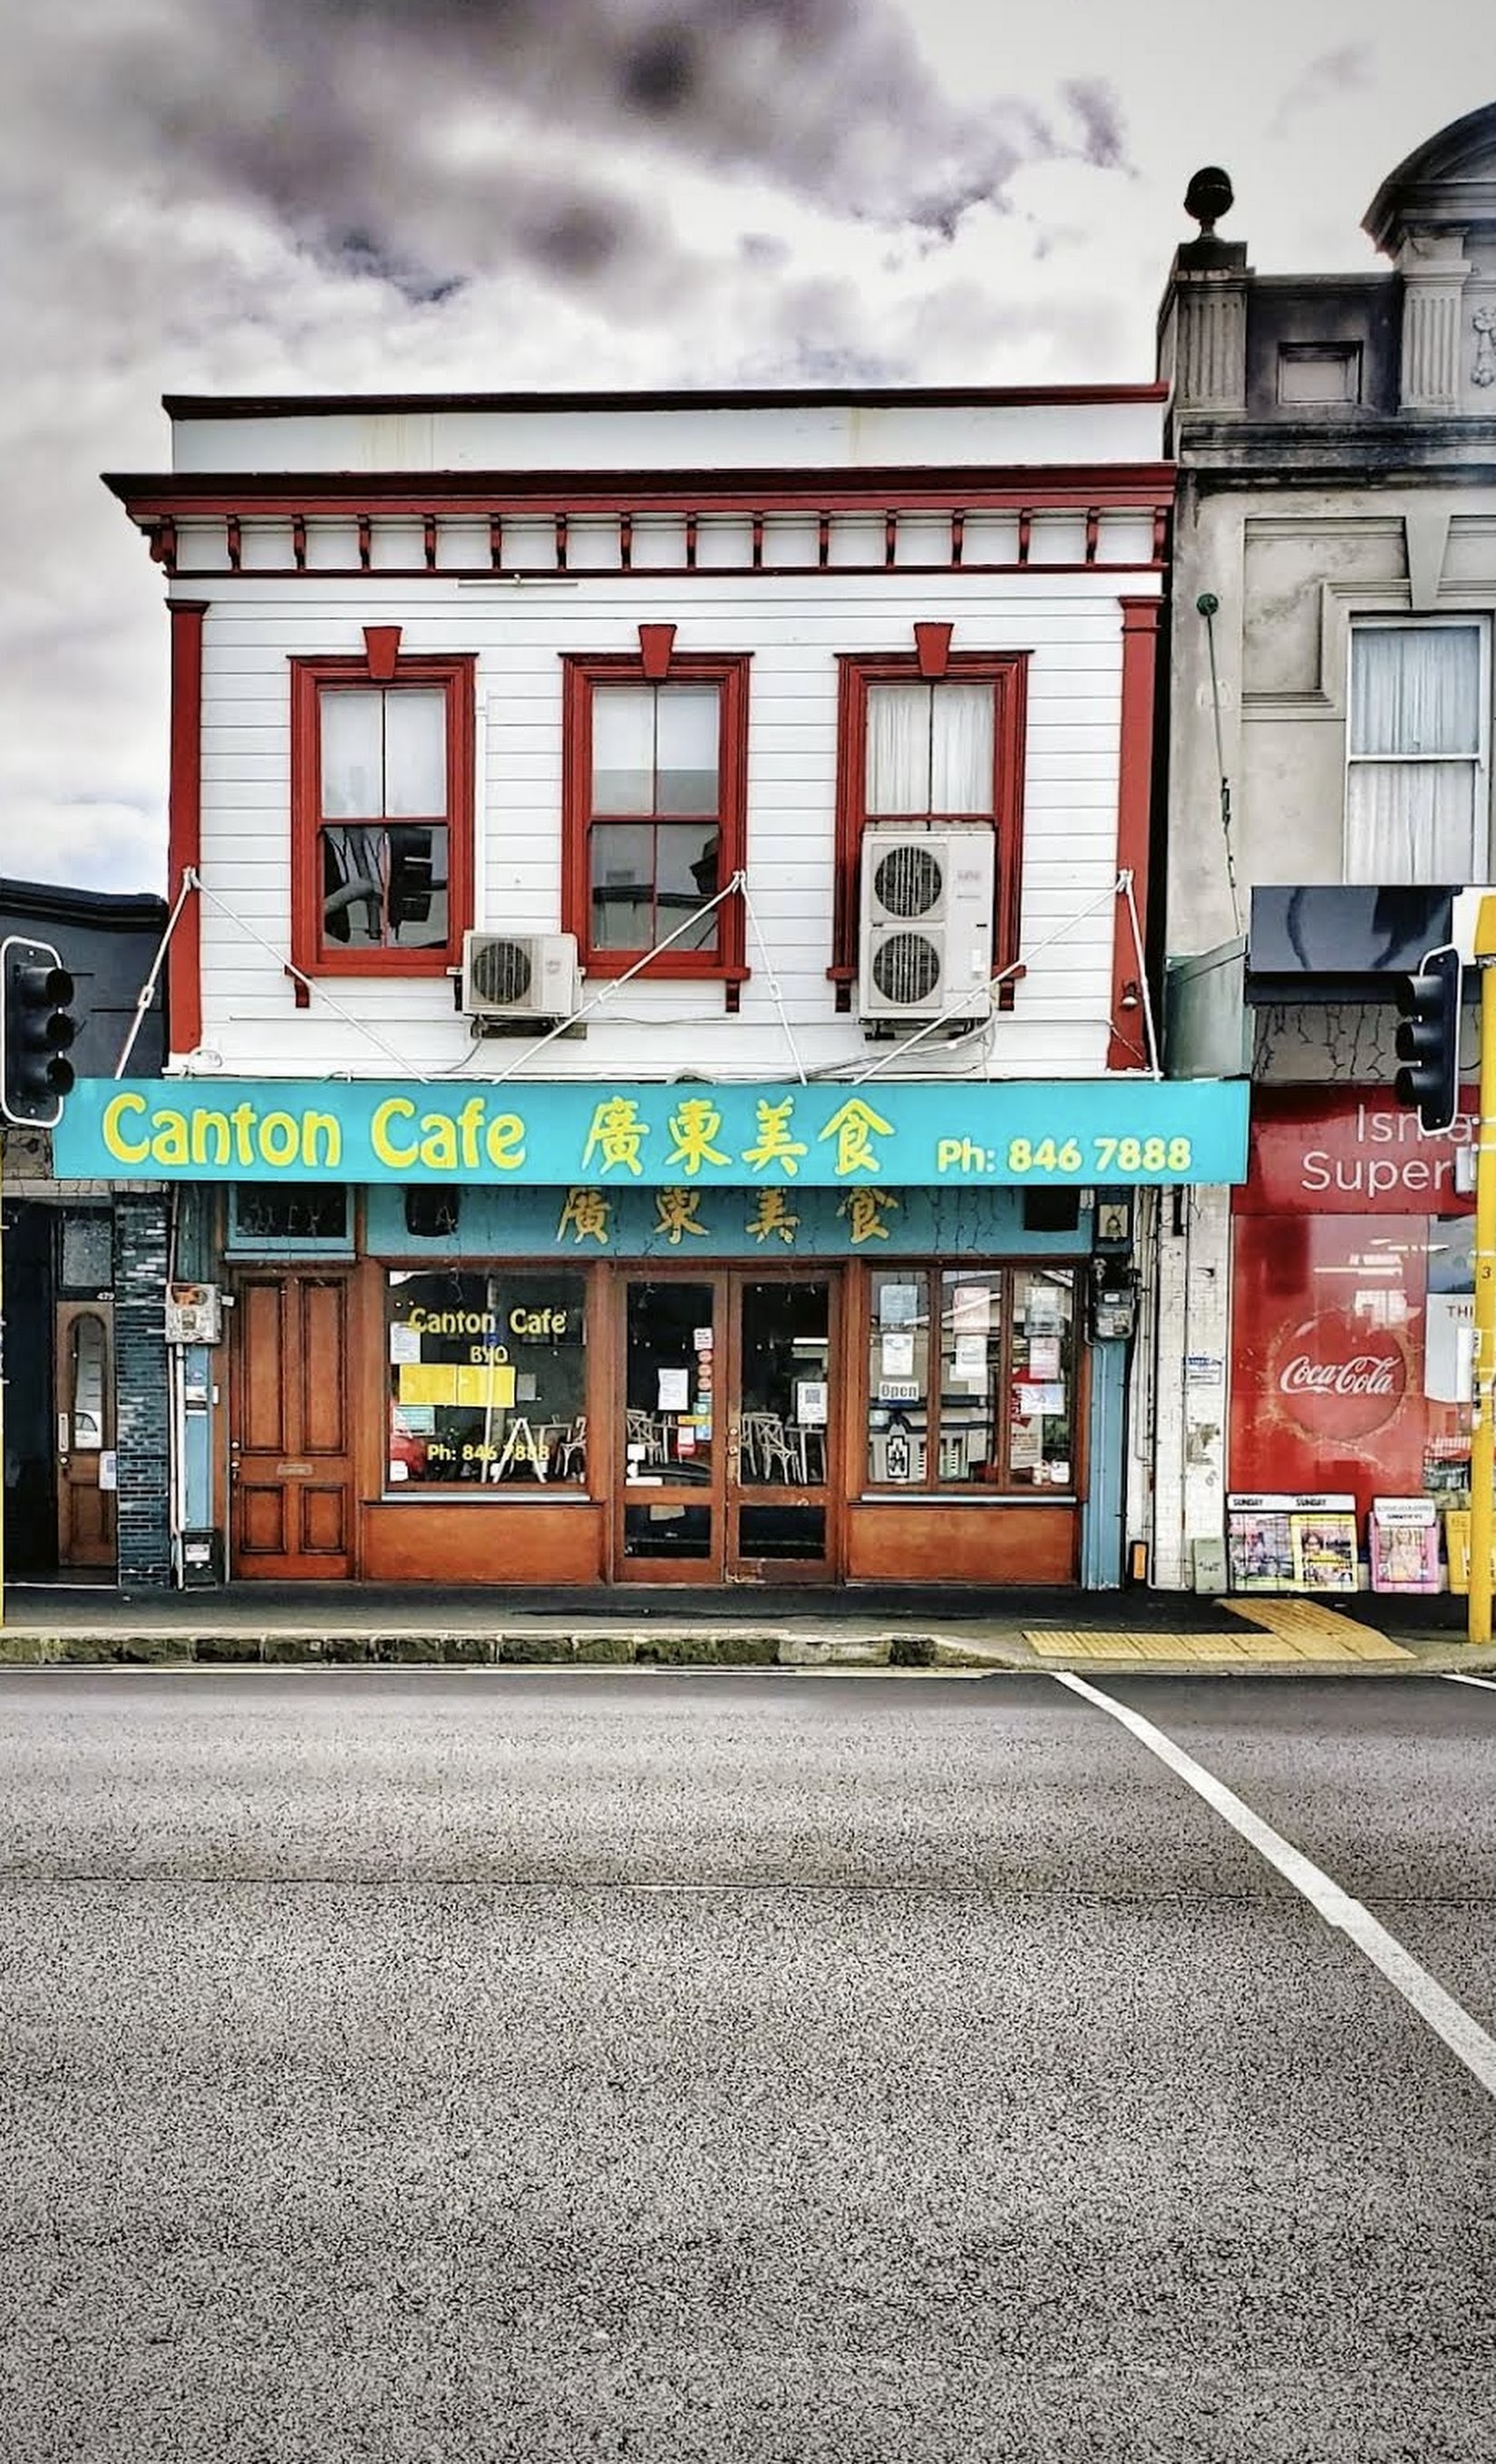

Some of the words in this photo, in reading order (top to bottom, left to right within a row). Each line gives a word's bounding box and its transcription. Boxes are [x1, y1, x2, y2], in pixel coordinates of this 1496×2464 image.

[102, 1091, 342, 1169] Canton
[371, 1097, 526, 1169] Cafe
[581, 1095, 896, 1177] 廣東美食
[937, 1137, 996, 1172] Ph:
[1008, 1138, 1083, 1172] 846
[1093, 1138, 1191, 1172] 7888
[1481, 1266, 1491, 1280] 3
[408, 1307, 497, 1334] Canton
[470, 1345, 509, 1363] BYO
[881, 1383, 918, 1398] Open
[427, 1443, 457, 1461] Ph:
[461, 1443, 498, 1461] 846
